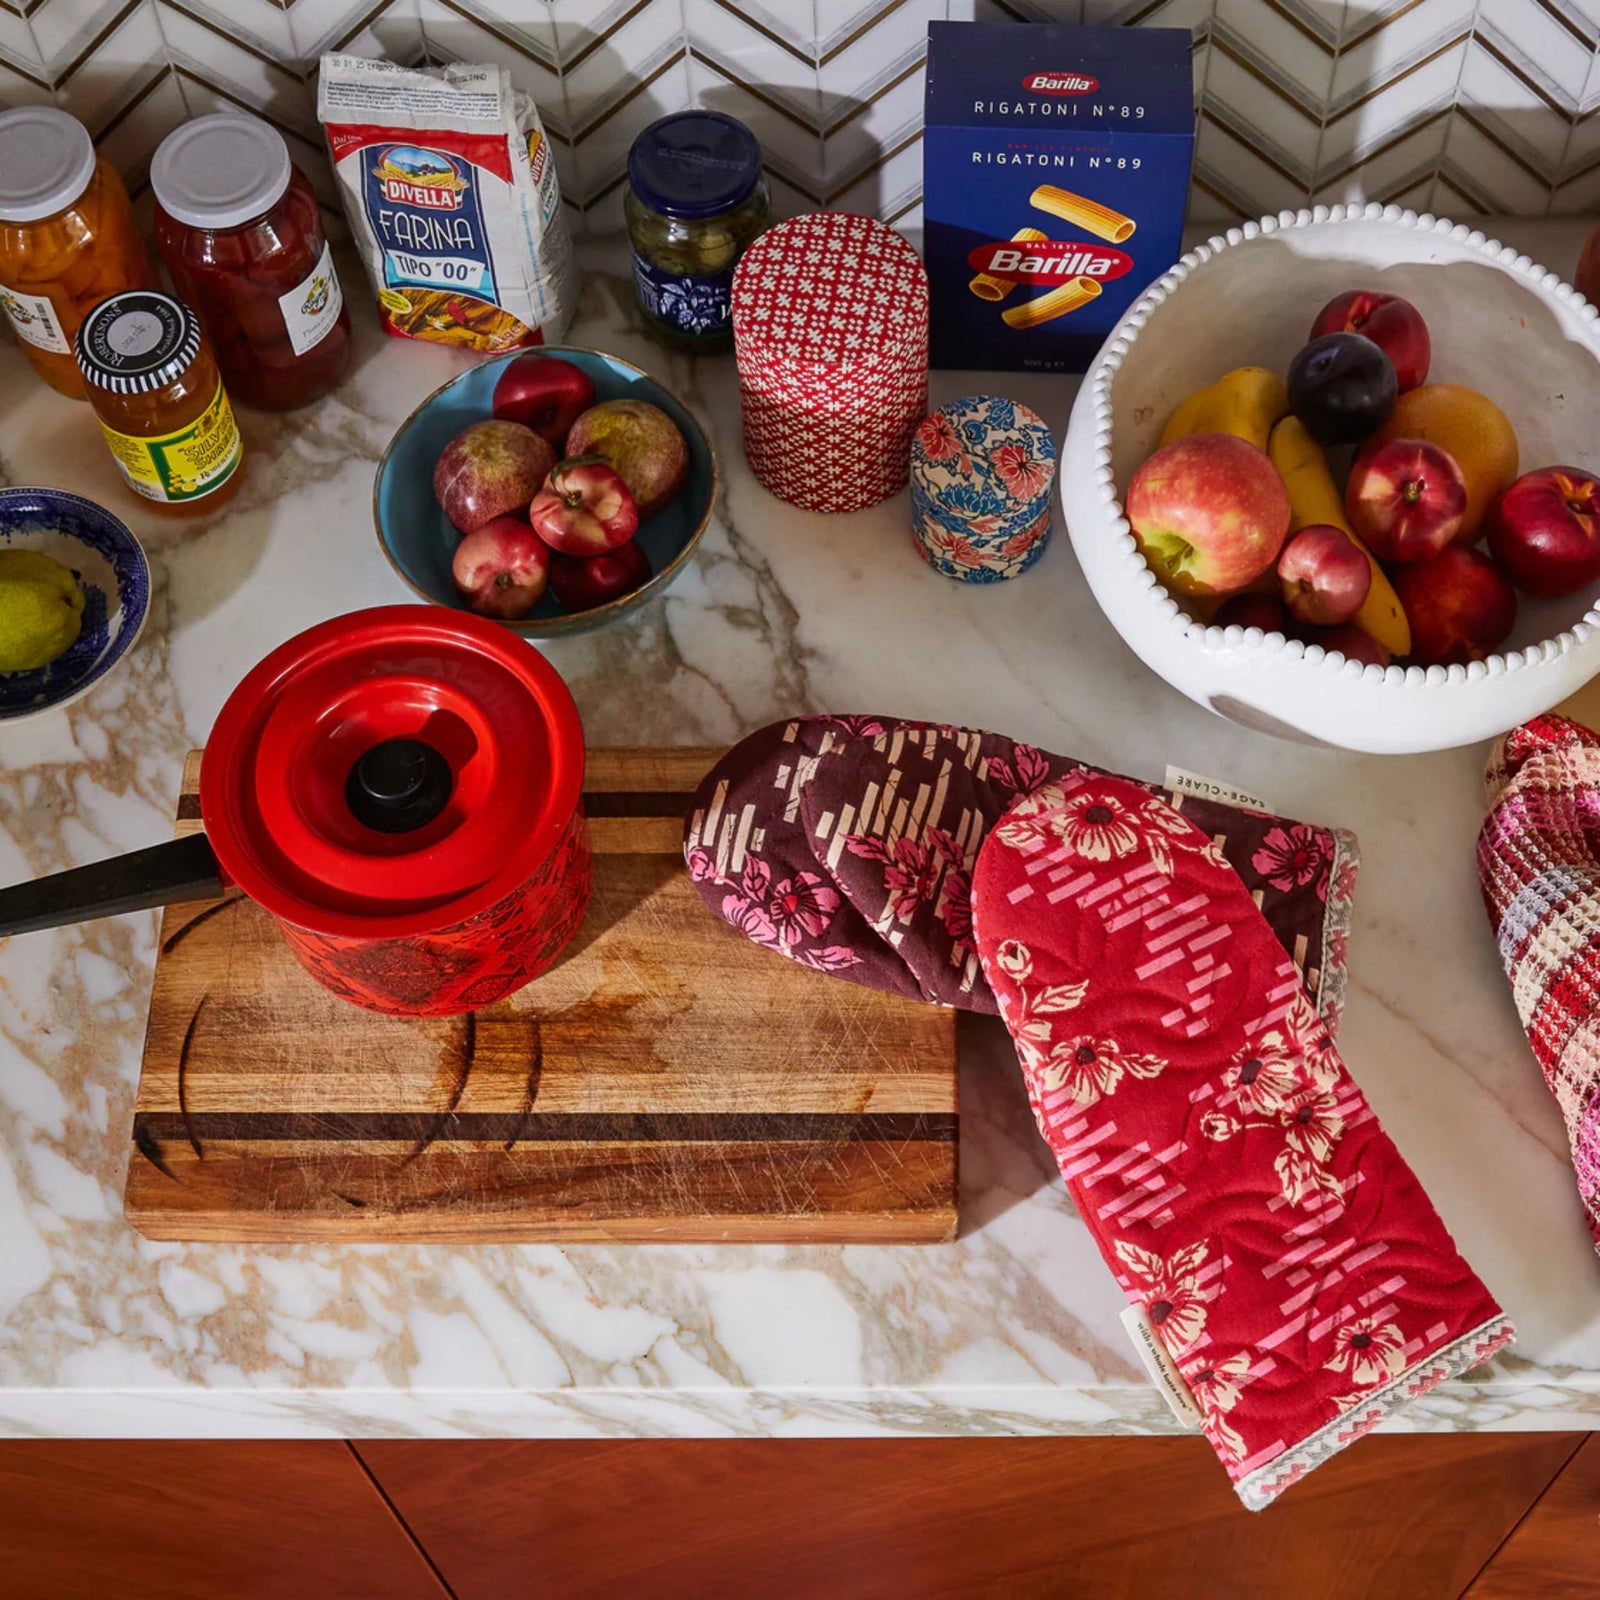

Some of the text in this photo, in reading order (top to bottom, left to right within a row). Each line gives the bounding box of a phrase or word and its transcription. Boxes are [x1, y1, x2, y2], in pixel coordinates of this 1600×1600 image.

[1031, 76, 1090, 91] Barilla
[974, 101, 1145, 118] RIGATONI N°89
[972, 152, 1141, 170] RIGATONI N°89
[389, 181, 454, 208] DIVELLA
[379, 210, 475, 250] FARINA
[396, 255, 432, 278] TIPO
[988, 251, 1112, 276] Barilla
[1177, 775, 1220, 795] CLARE
[1137, 1322, 1150, 1342] with
[1151, 1348, 1166, 1373] whole
